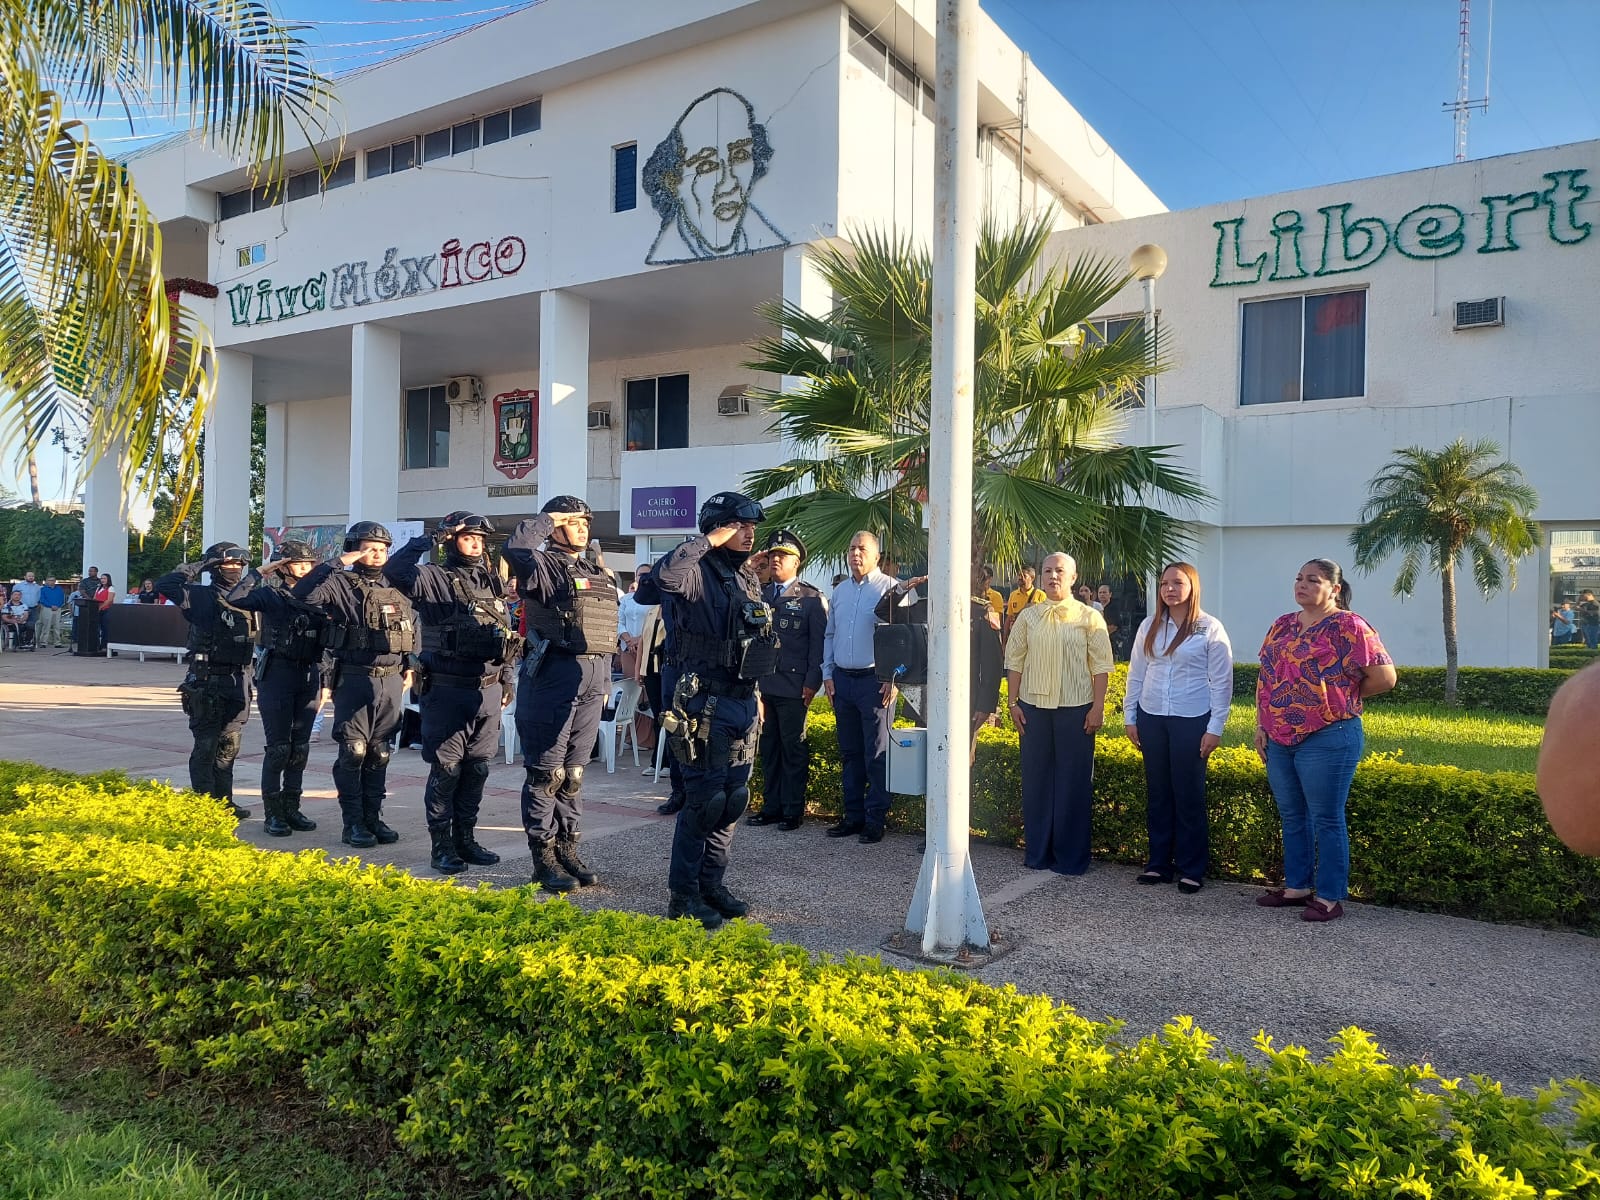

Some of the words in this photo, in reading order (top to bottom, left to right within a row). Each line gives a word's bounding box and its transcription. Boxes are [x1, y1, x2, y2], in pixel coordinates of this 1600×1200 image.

[1209, 169, 1592, 288] Libert
[226, 272, 327, 326] Viva
[329, 236, 526, 311] México
[637, 508, 688, 518] AUTOMATICO
[648, 497, 676, 507] CAJERO
